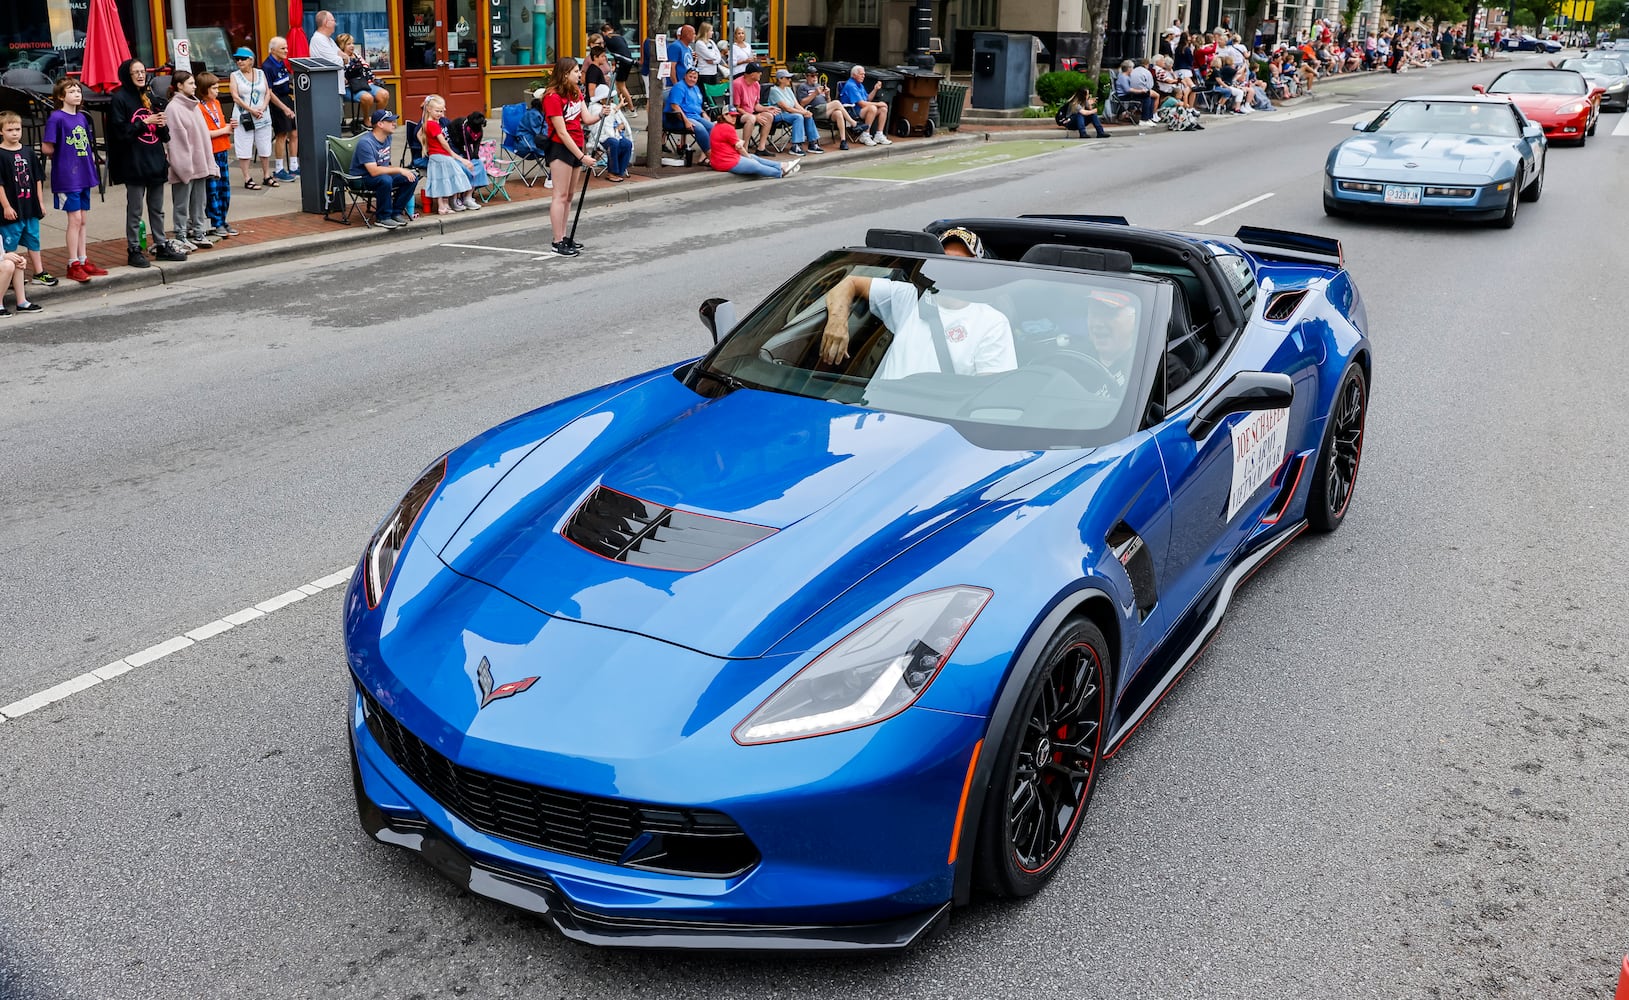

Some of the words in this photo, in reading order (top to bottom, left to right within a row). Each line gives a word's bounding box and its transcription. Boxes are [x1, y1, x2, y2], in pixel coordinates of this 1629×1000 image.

[408, 25, 430, 33] MIAMI
[9, 41, 52, 50] DOWNTOWN
[1236, 427, 1250, 463] JOE
[1257, 431, 1276, 463] ARMY
[1231, 462, 1265, 511] VIETNAM
[1265, 444, 1282, 474] WAR
